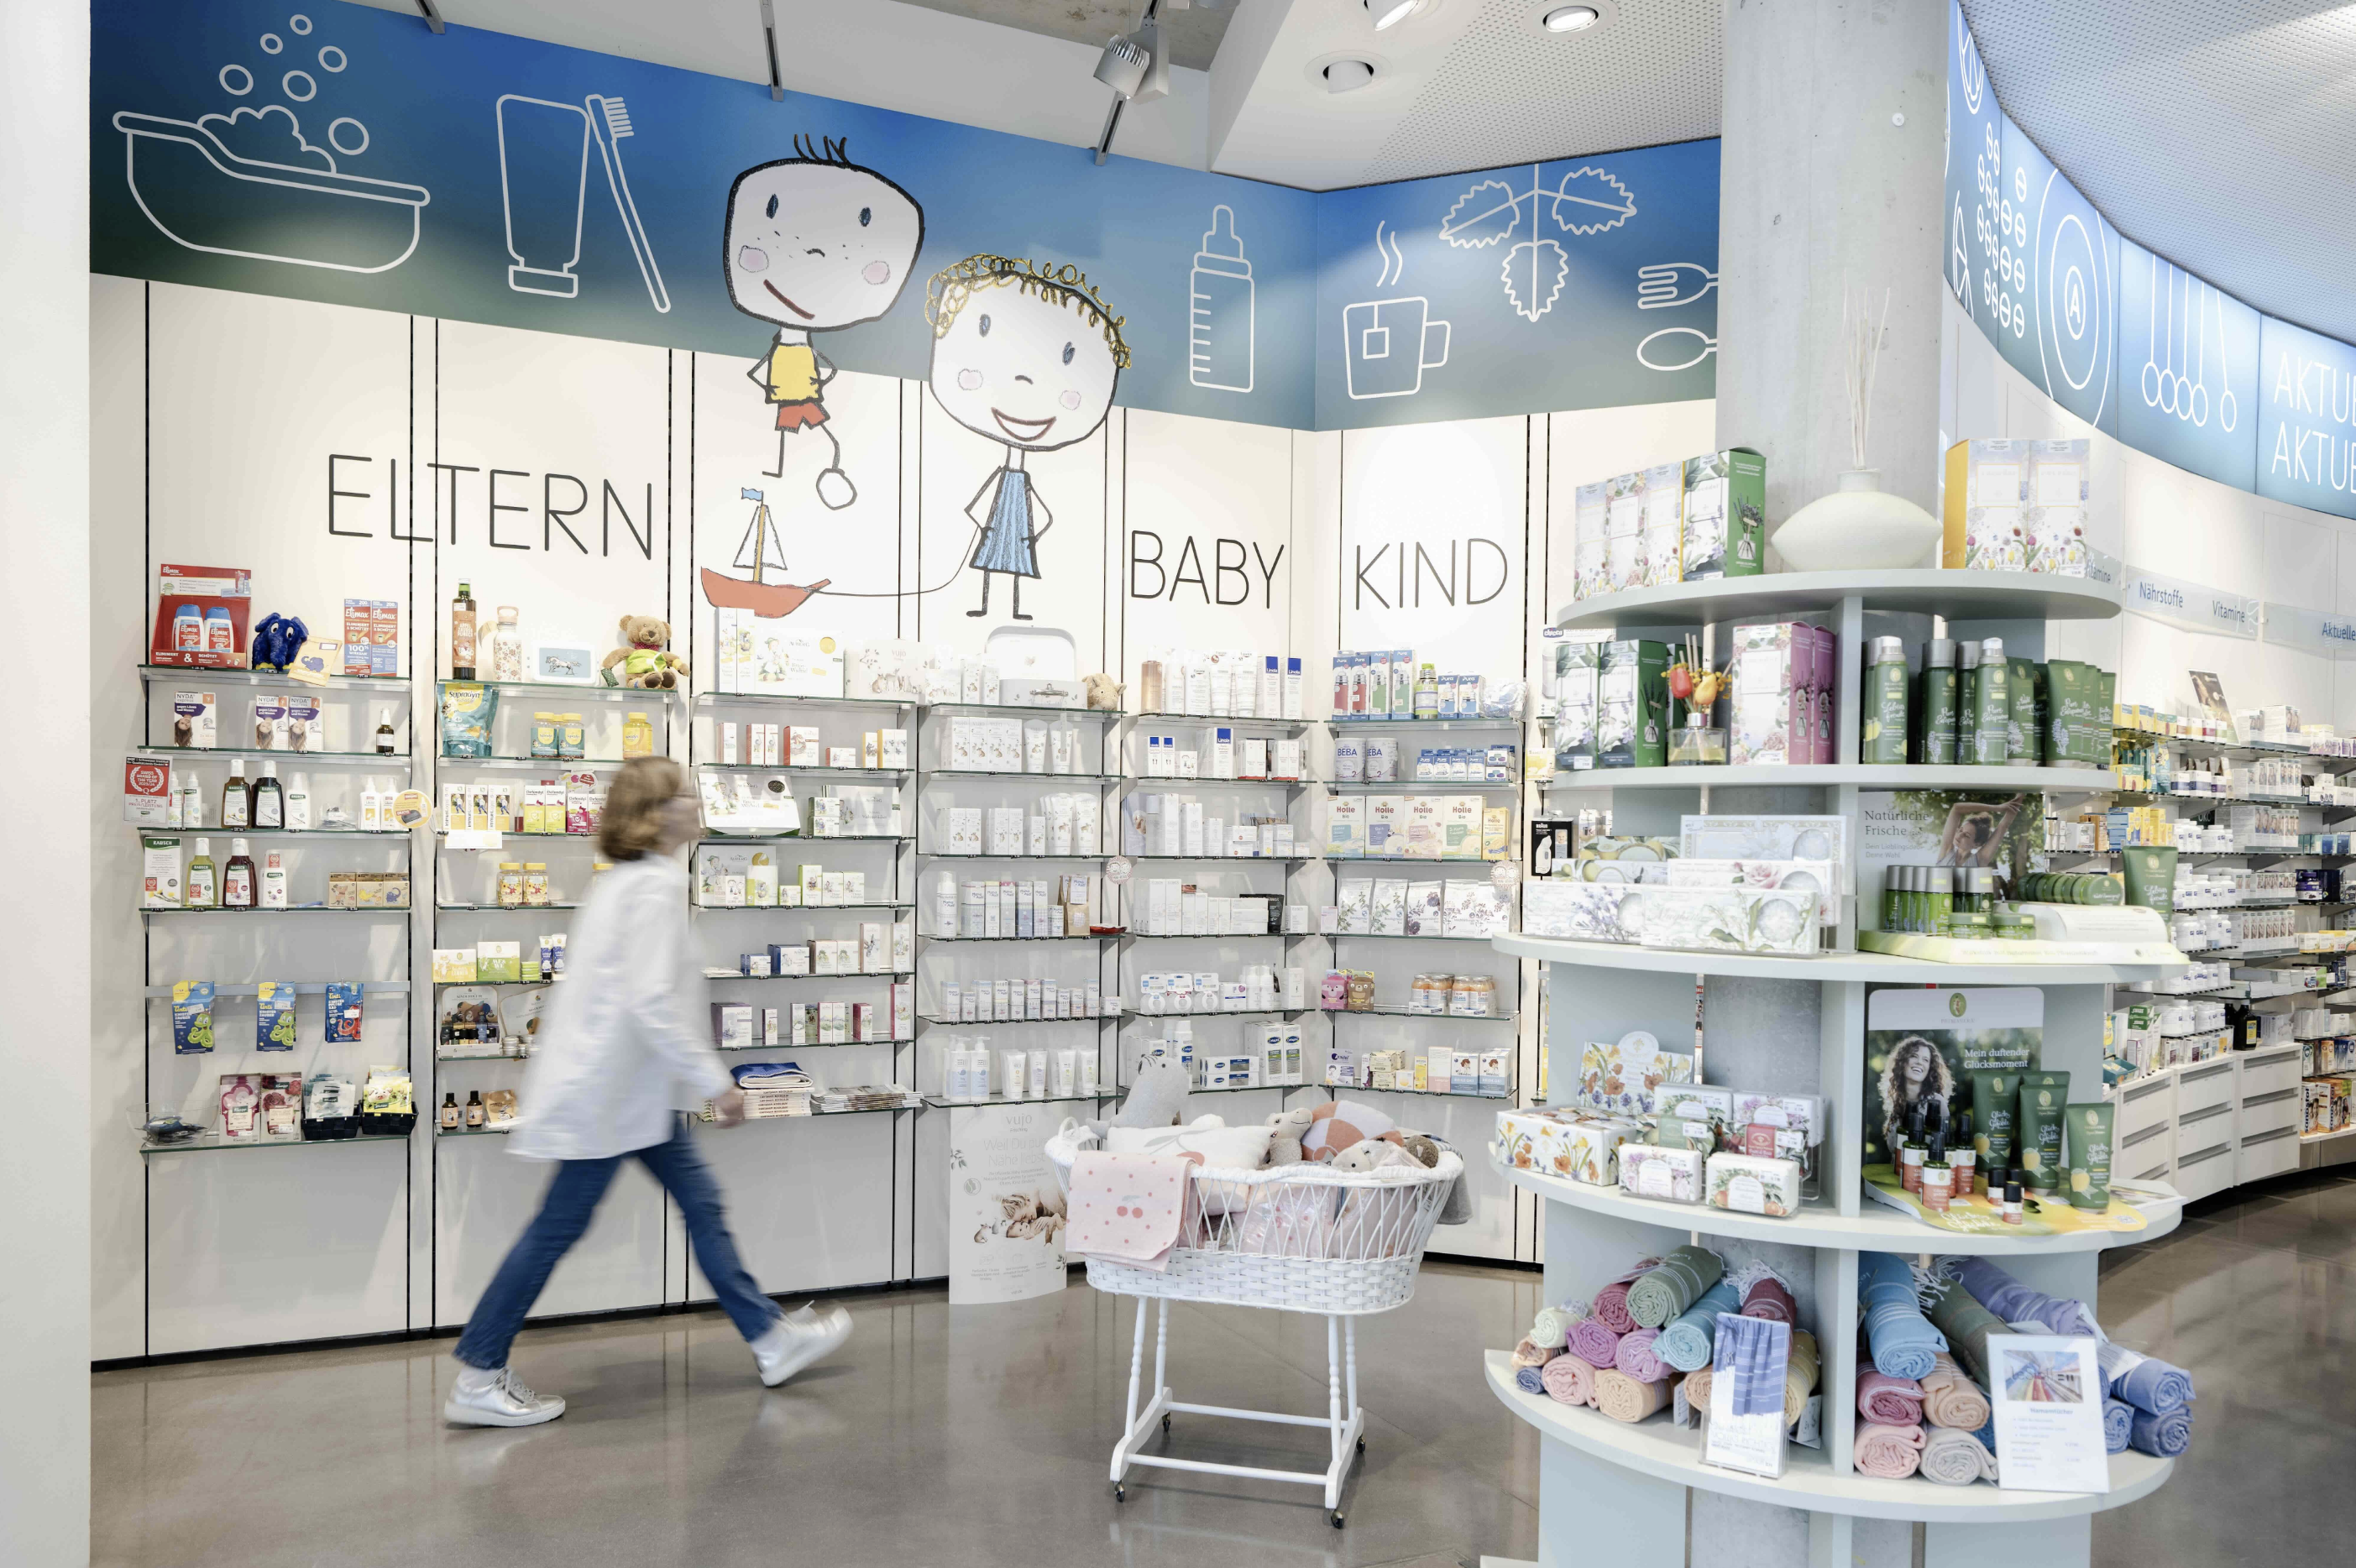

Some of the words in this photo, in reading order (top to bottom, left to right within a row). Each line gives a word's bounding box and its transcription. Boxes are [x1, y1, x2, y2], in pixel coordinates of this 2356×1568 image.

[2274, 352, 2356, 423] AKTU
[2271, 421, 2356, 493] AKTU
[328, 454, 653, 561] ELTERN
[1131, 530, 1285, 609] BABY
[1355, 537, 1508, 610] KIND
[2086, 560, 2112, 583] itamine
[2139, 582, 2184, 609] Nährstoffe
[345, 607, 369, 619] Elimax
[373, 609, 396, 620] Elimax
[2212, 600, 2246, 623] Vitamine
[183, 653, 193, 663] &
[1338, 748, 1358, 756] BEBA
[1336, 806, 1355, 814] Holle
[1374, 806, 1395, 814] Holle
[1413, 806, 1433, 814] Holle
[1452, 806, 1472, 814] Holle
[1864, 810, 1929, 821] Natürliche
[1865, 825, 1907, 836] Frische
[1965, 1049, 1987, 1058] Mein
[1988, 1048, 2030, 1057] duftender
[1964, 1060, 2029, 1069] Glücksmoment
[1005, 1113, 1033, 1126] vujo
[984, 1137, 1008, 1151] Weil
[1011, 1137, 1026, 1150] Du
[989, 1153, 1018, 1168] Nähe
[1020, 1151, 1046, 1164] liebst
[2029, 1408, 2074, 1416] Hamamtücher
